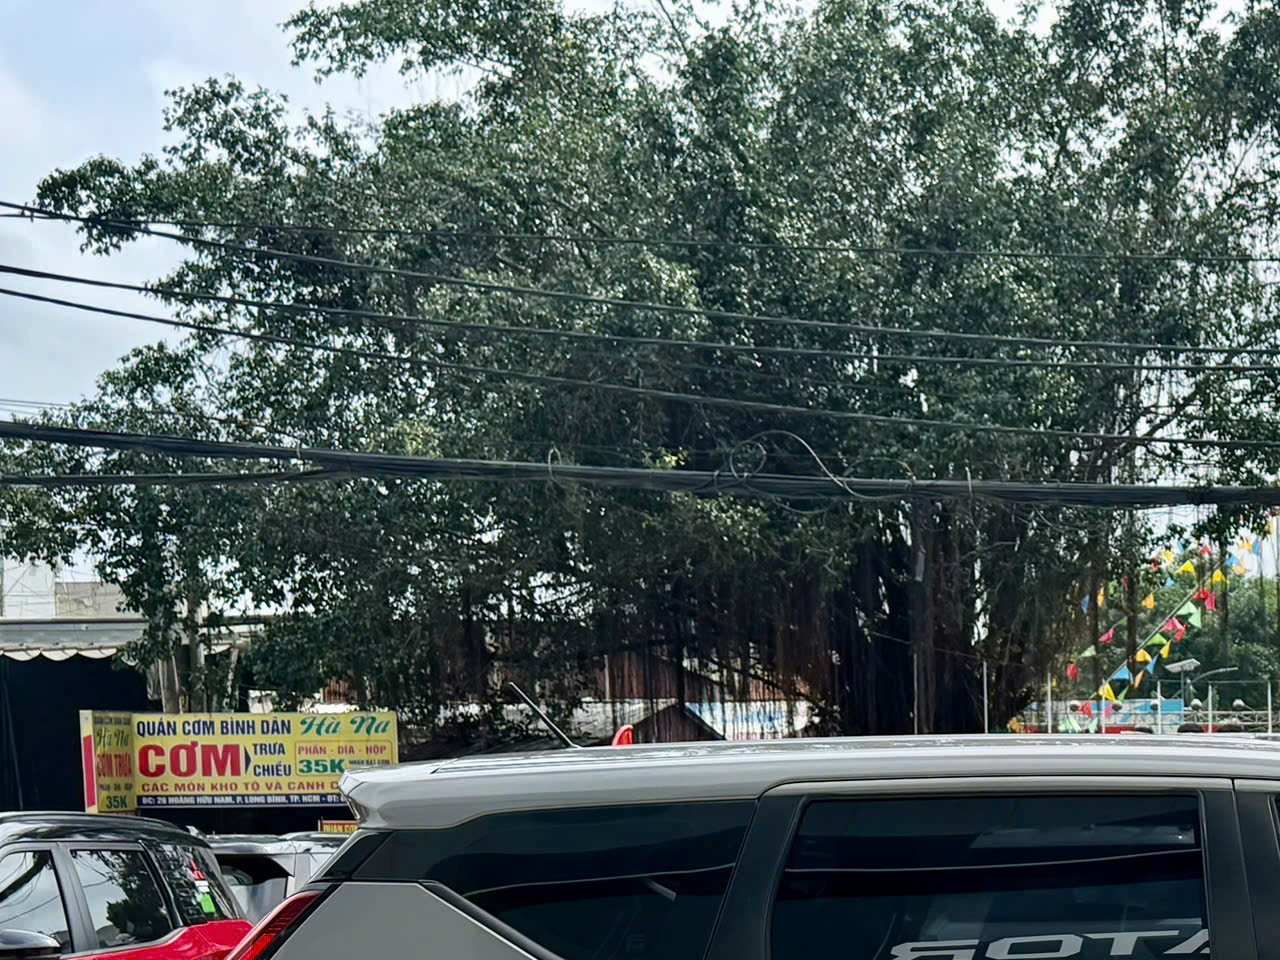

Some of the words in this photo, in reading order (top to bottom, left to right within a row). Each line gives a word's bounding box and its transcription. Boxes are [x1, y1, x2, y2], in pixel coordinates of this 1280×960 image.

[136, 717, 177, 738] QUÁN
[182, 719, 215, 736] CƠM
[220, 717, 256, 736] BÌNH
[261, 716, 291, 735] DÂN
[300, 715, 341, 736] Hà
[349, 715, 391, 736] Na
[252, 742, 285, 755] TRƯA
[138, 740, 242, 778] CƠM
[298, 759, 345, 773] 35K
[210, 781, 239, 792] KHO
[287, 780, 325, 791] CANH
[105, 795, 128, 809] 35K
